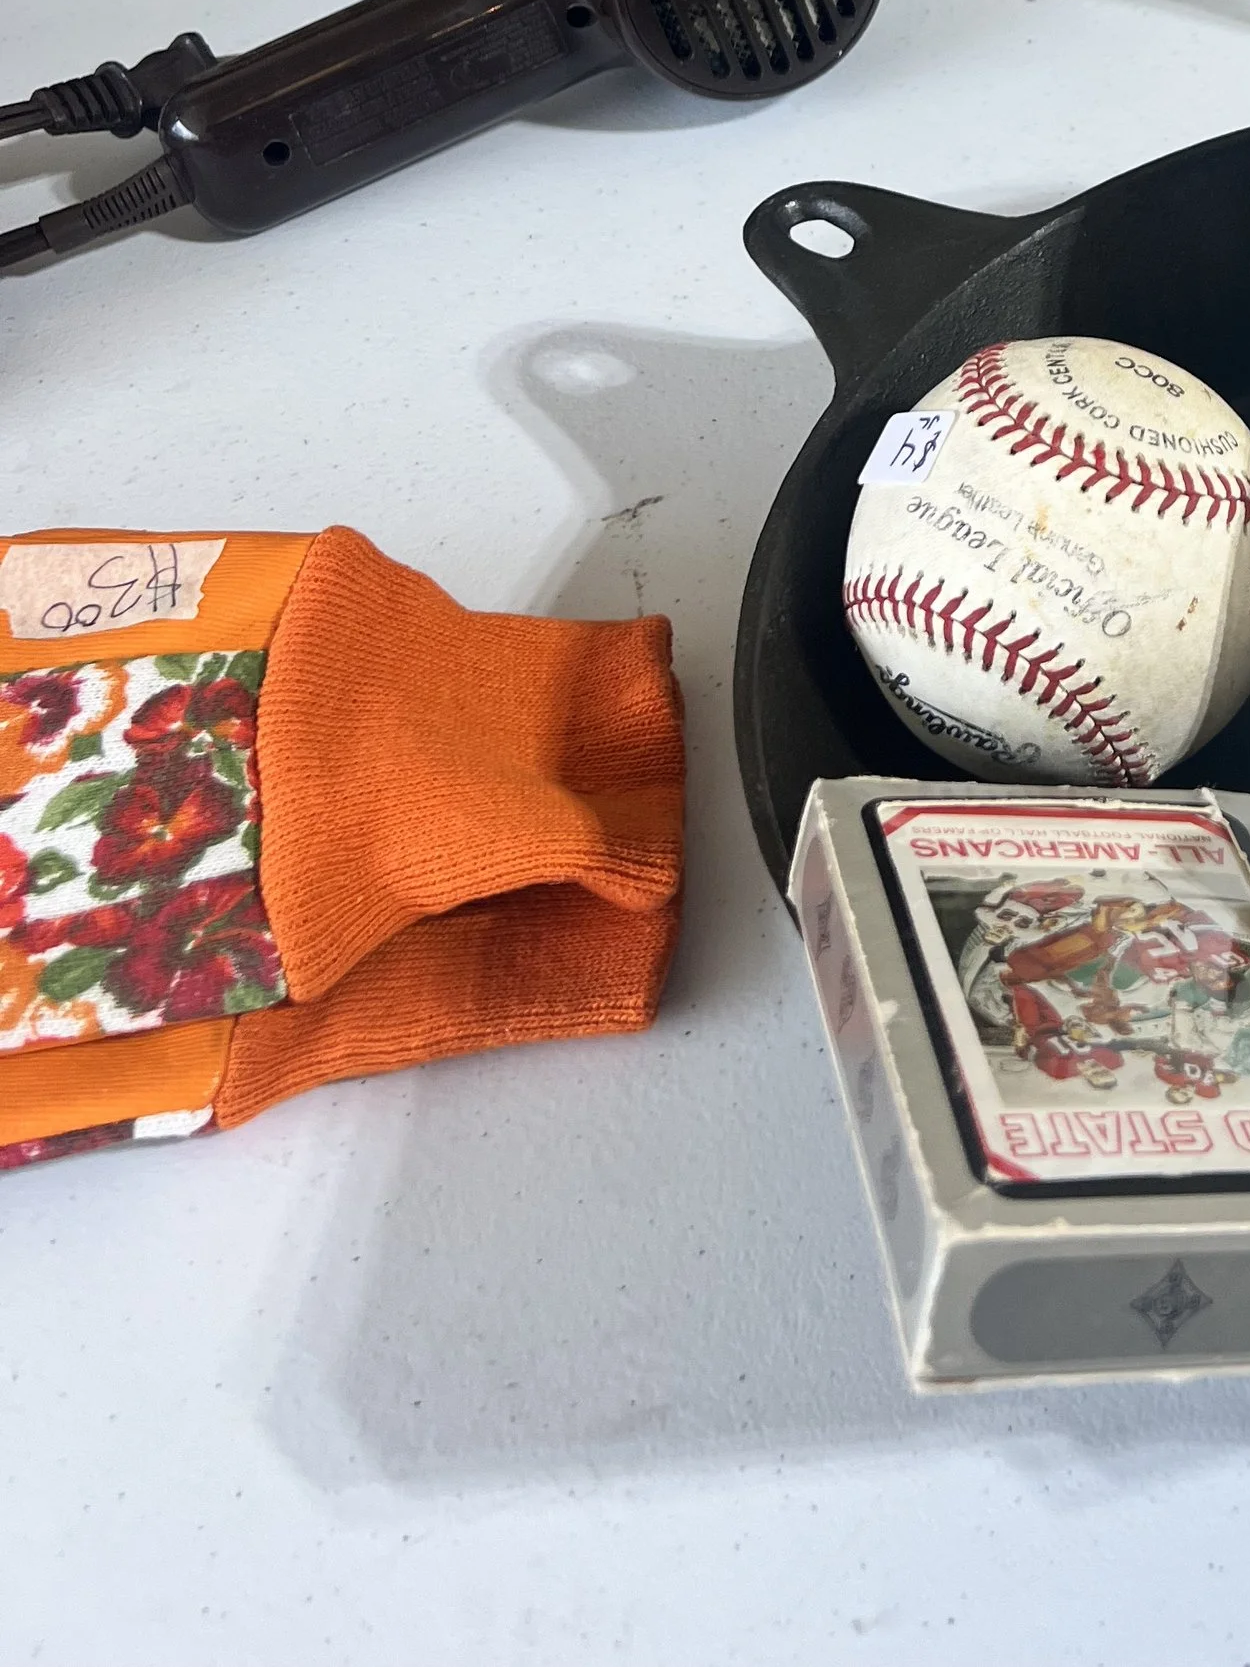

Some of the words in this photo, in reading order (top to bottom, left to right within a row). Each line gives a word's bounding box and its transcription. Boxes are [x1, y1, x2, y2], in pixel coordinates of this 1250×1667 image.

[1062, 386, 1121, 430] CORK
[890, 428, 942, 472] $4
[1129, 424, 1239, 456] CUSHIONED
[958, 482, 1024, 532] Leather
[907, 495, 1009, 573] League
[1010, 556, 1132, 637] Official
[876, 664, 1042, 765] Rawlings
[1055, 830, 1131, 840] FOOTBALL
[1000, 1110, 1216, 1158] STATE
